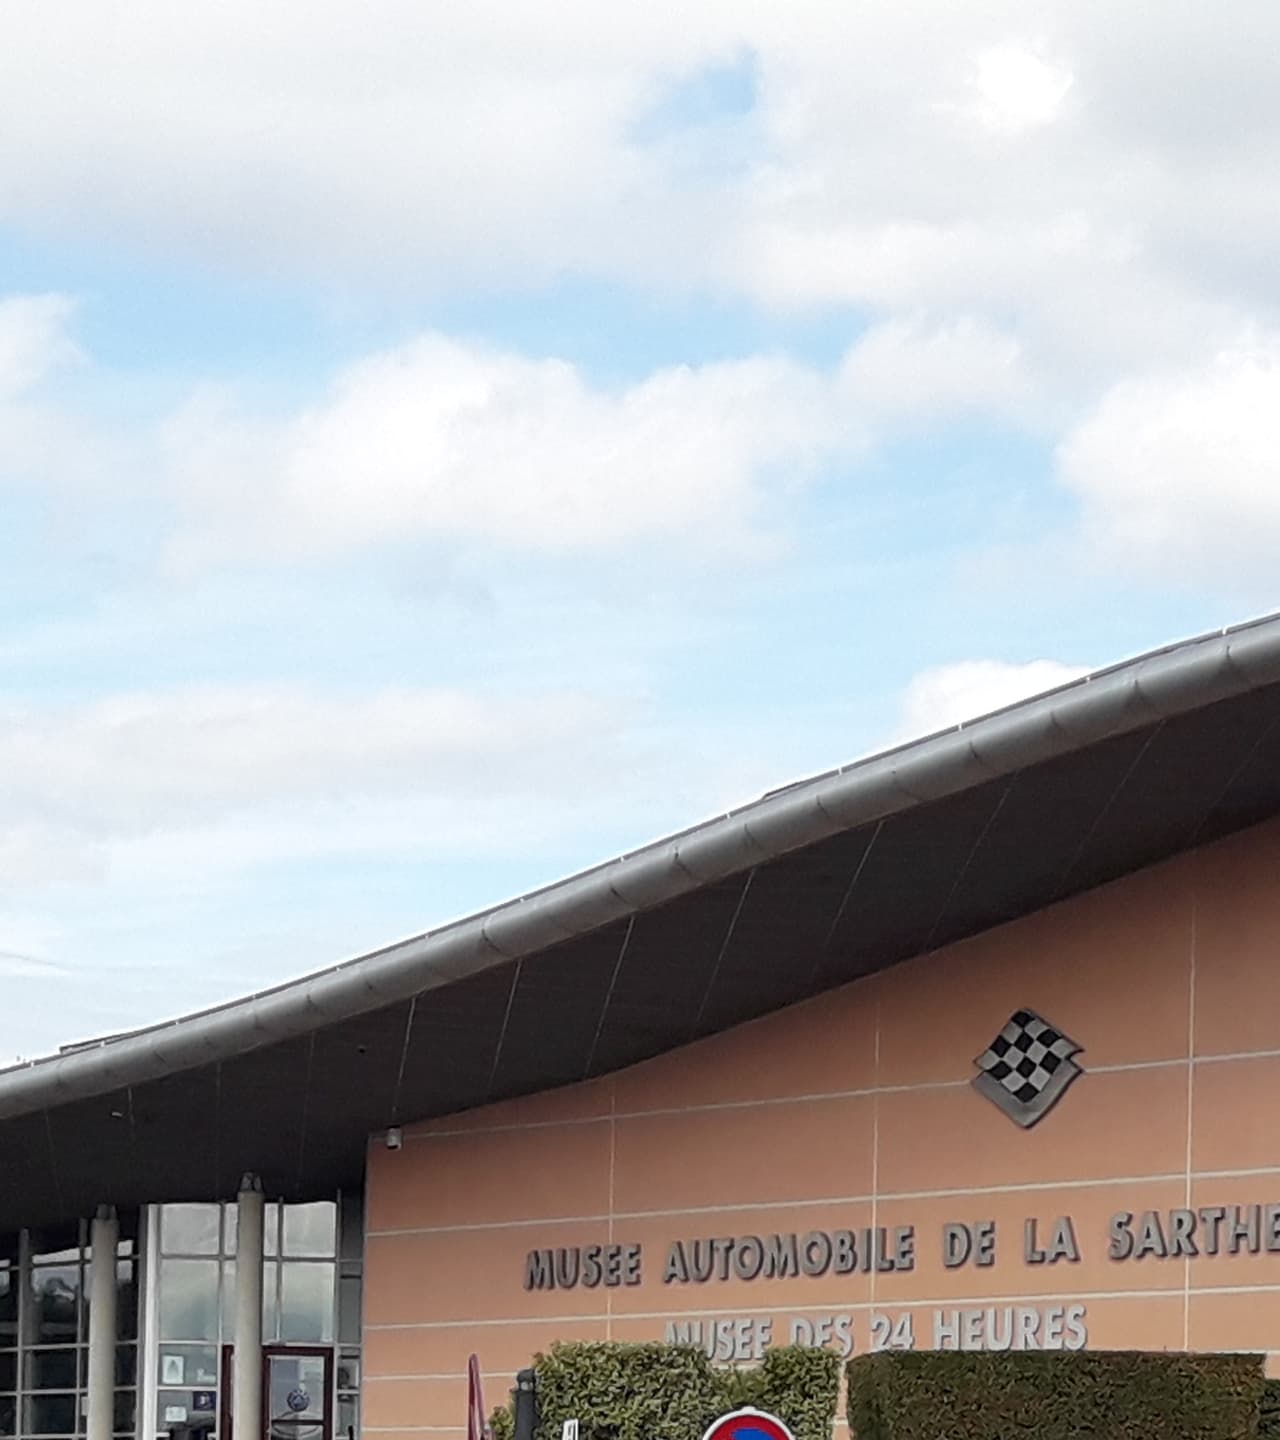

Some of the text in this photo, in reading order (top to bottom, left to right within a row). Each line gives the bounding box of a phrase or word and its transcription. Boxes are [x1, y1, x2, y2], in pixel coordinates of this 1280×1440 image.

[524, 1243, 641, 1290] MUSEE
[664, 1226, 916, 1284] AUTOMOBILE
[944, 1221, 995, 1268] DE
[1025, 1216, 1081, 1265] LA
[872, 1311, 915, 1351] 24
[934, 1304, 1088, 1351] HEURES
